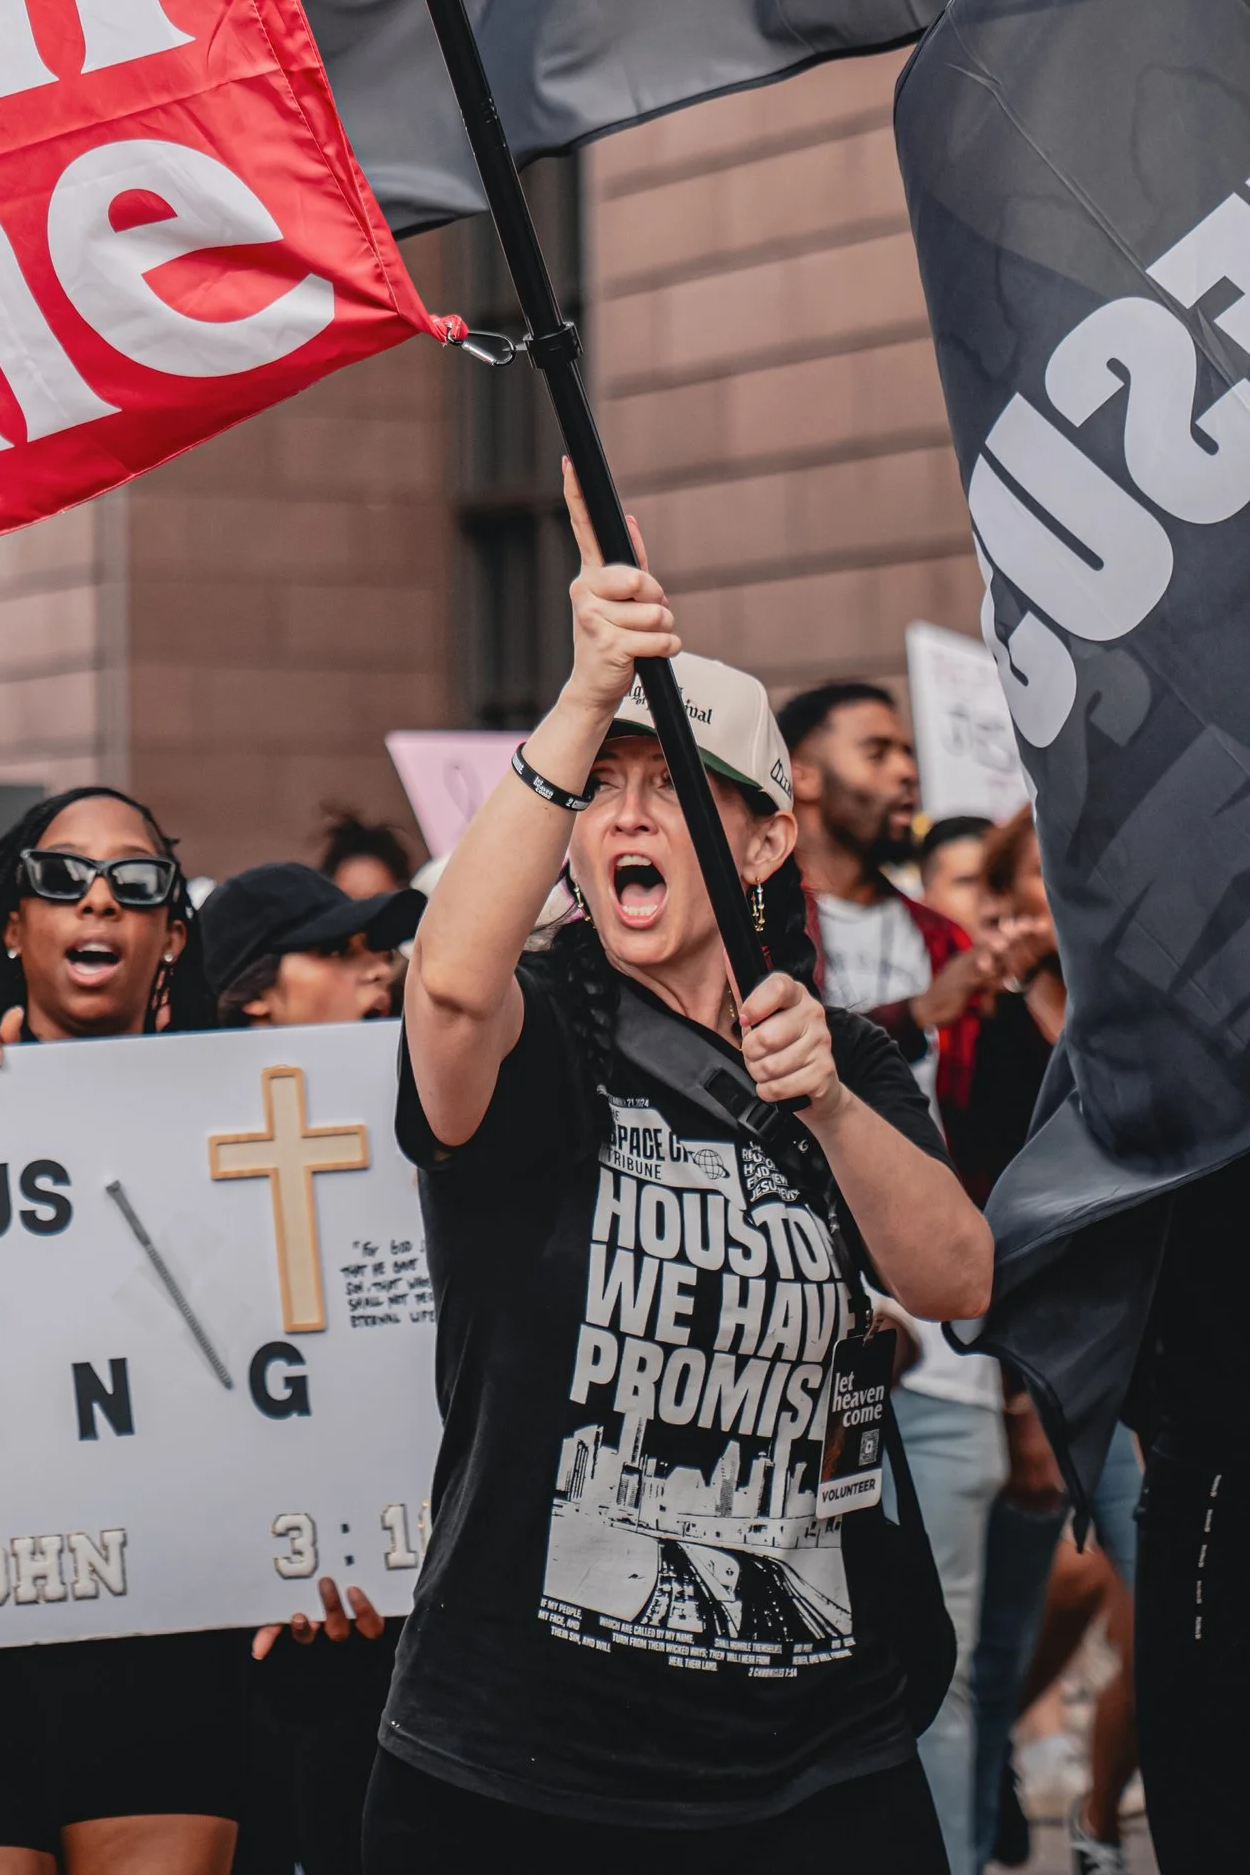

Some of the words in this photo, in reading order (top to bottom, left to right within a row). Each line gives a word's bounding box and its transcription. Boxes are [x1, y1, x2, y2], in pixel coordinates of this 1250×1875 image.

[607, 1147, 662, 1181] TRIBUNE
[586, 1242, 698, 1347] WE
[569, 1323, 830, 1442] PROMIS
[835, 1371, 855, 1396] let
[832, 1384, 885, 1413] heaven
[842, 1403, 884, 1429] come
[821, 1478, 876, 1503] VOLUNTEER
